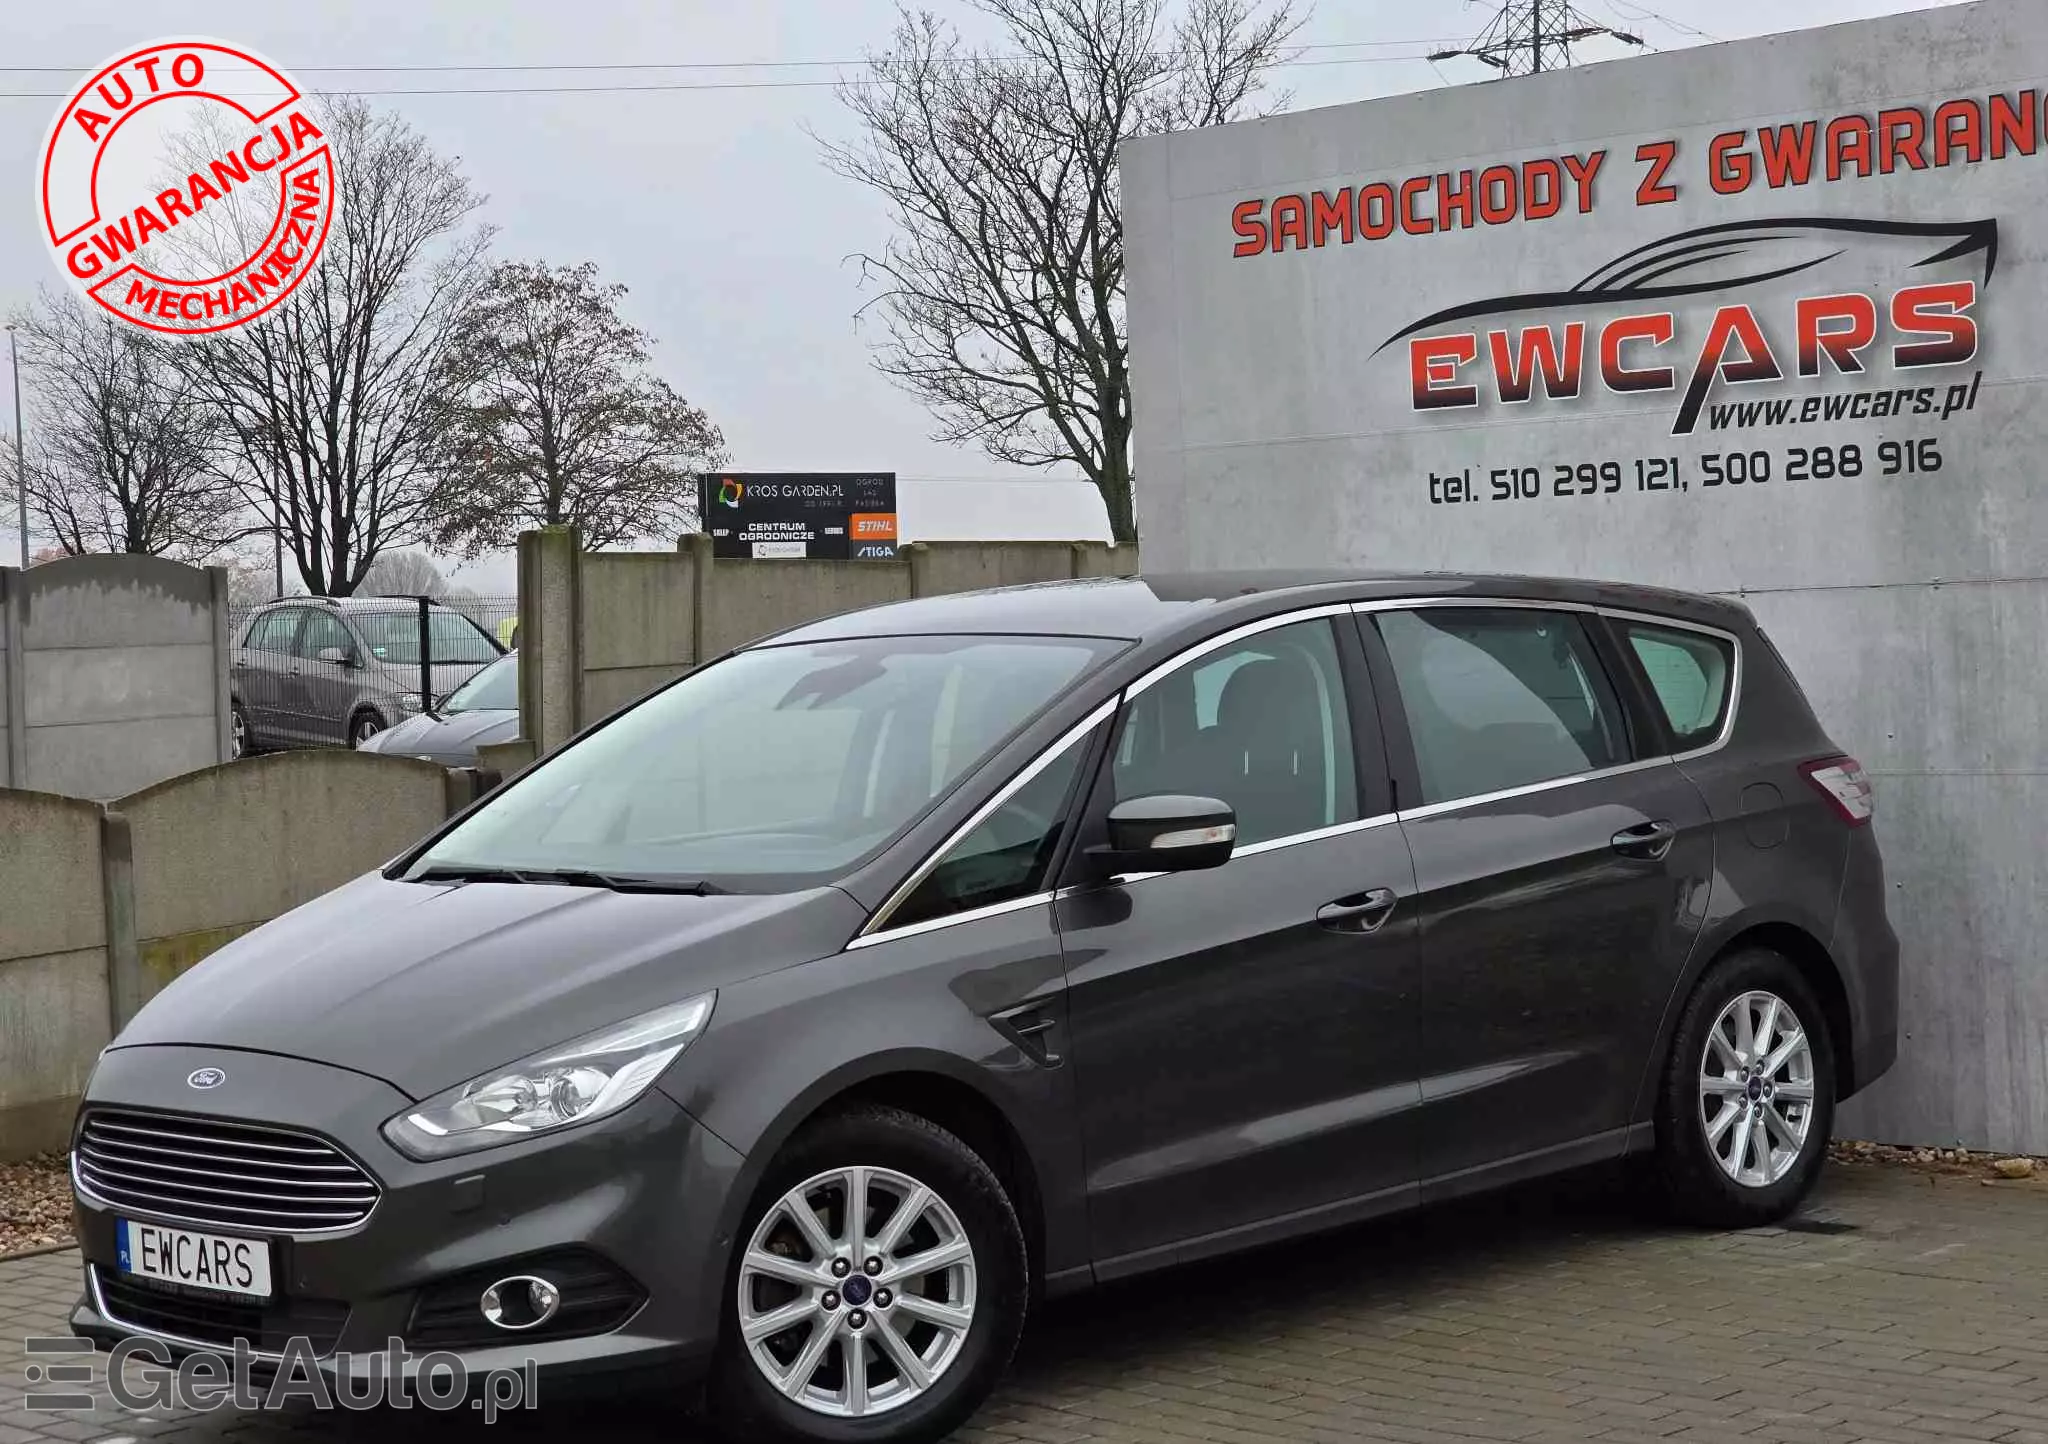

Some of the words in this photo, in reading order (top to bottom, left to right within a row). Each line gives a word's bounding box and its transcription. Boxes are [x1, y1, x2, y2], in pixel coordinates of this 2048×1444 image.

[1232, 149, 1607, 258] SAMOCHODY
[1636, 140, 1677, 206] Z
[1709, 88, 2048, 195] GWARAN
[1408, 280, 1979, 436] EWCARS
[1707, 371, 1984, 432] www.ewcars.pl
[747, 485, 778, 497] KROS
[1428, 467, 1477, 506] tel.
[1491, 467, 1540, 502] 510
[1553, 462, 1622, 496] 299
[1635, 457, 1689, 495] 121,
[1701, 450, 1771, 488] 500
[1787, 445, 1864, 482] 288
[1878, 438, 1943, 475] 916
[738, 531, 815, 541] OGRODNICZE
[748, 522, 806, 532] CENTRUM
[857, 520, 893, 532] STIHL
[140, 1228, 253, 1288] EWCARS
